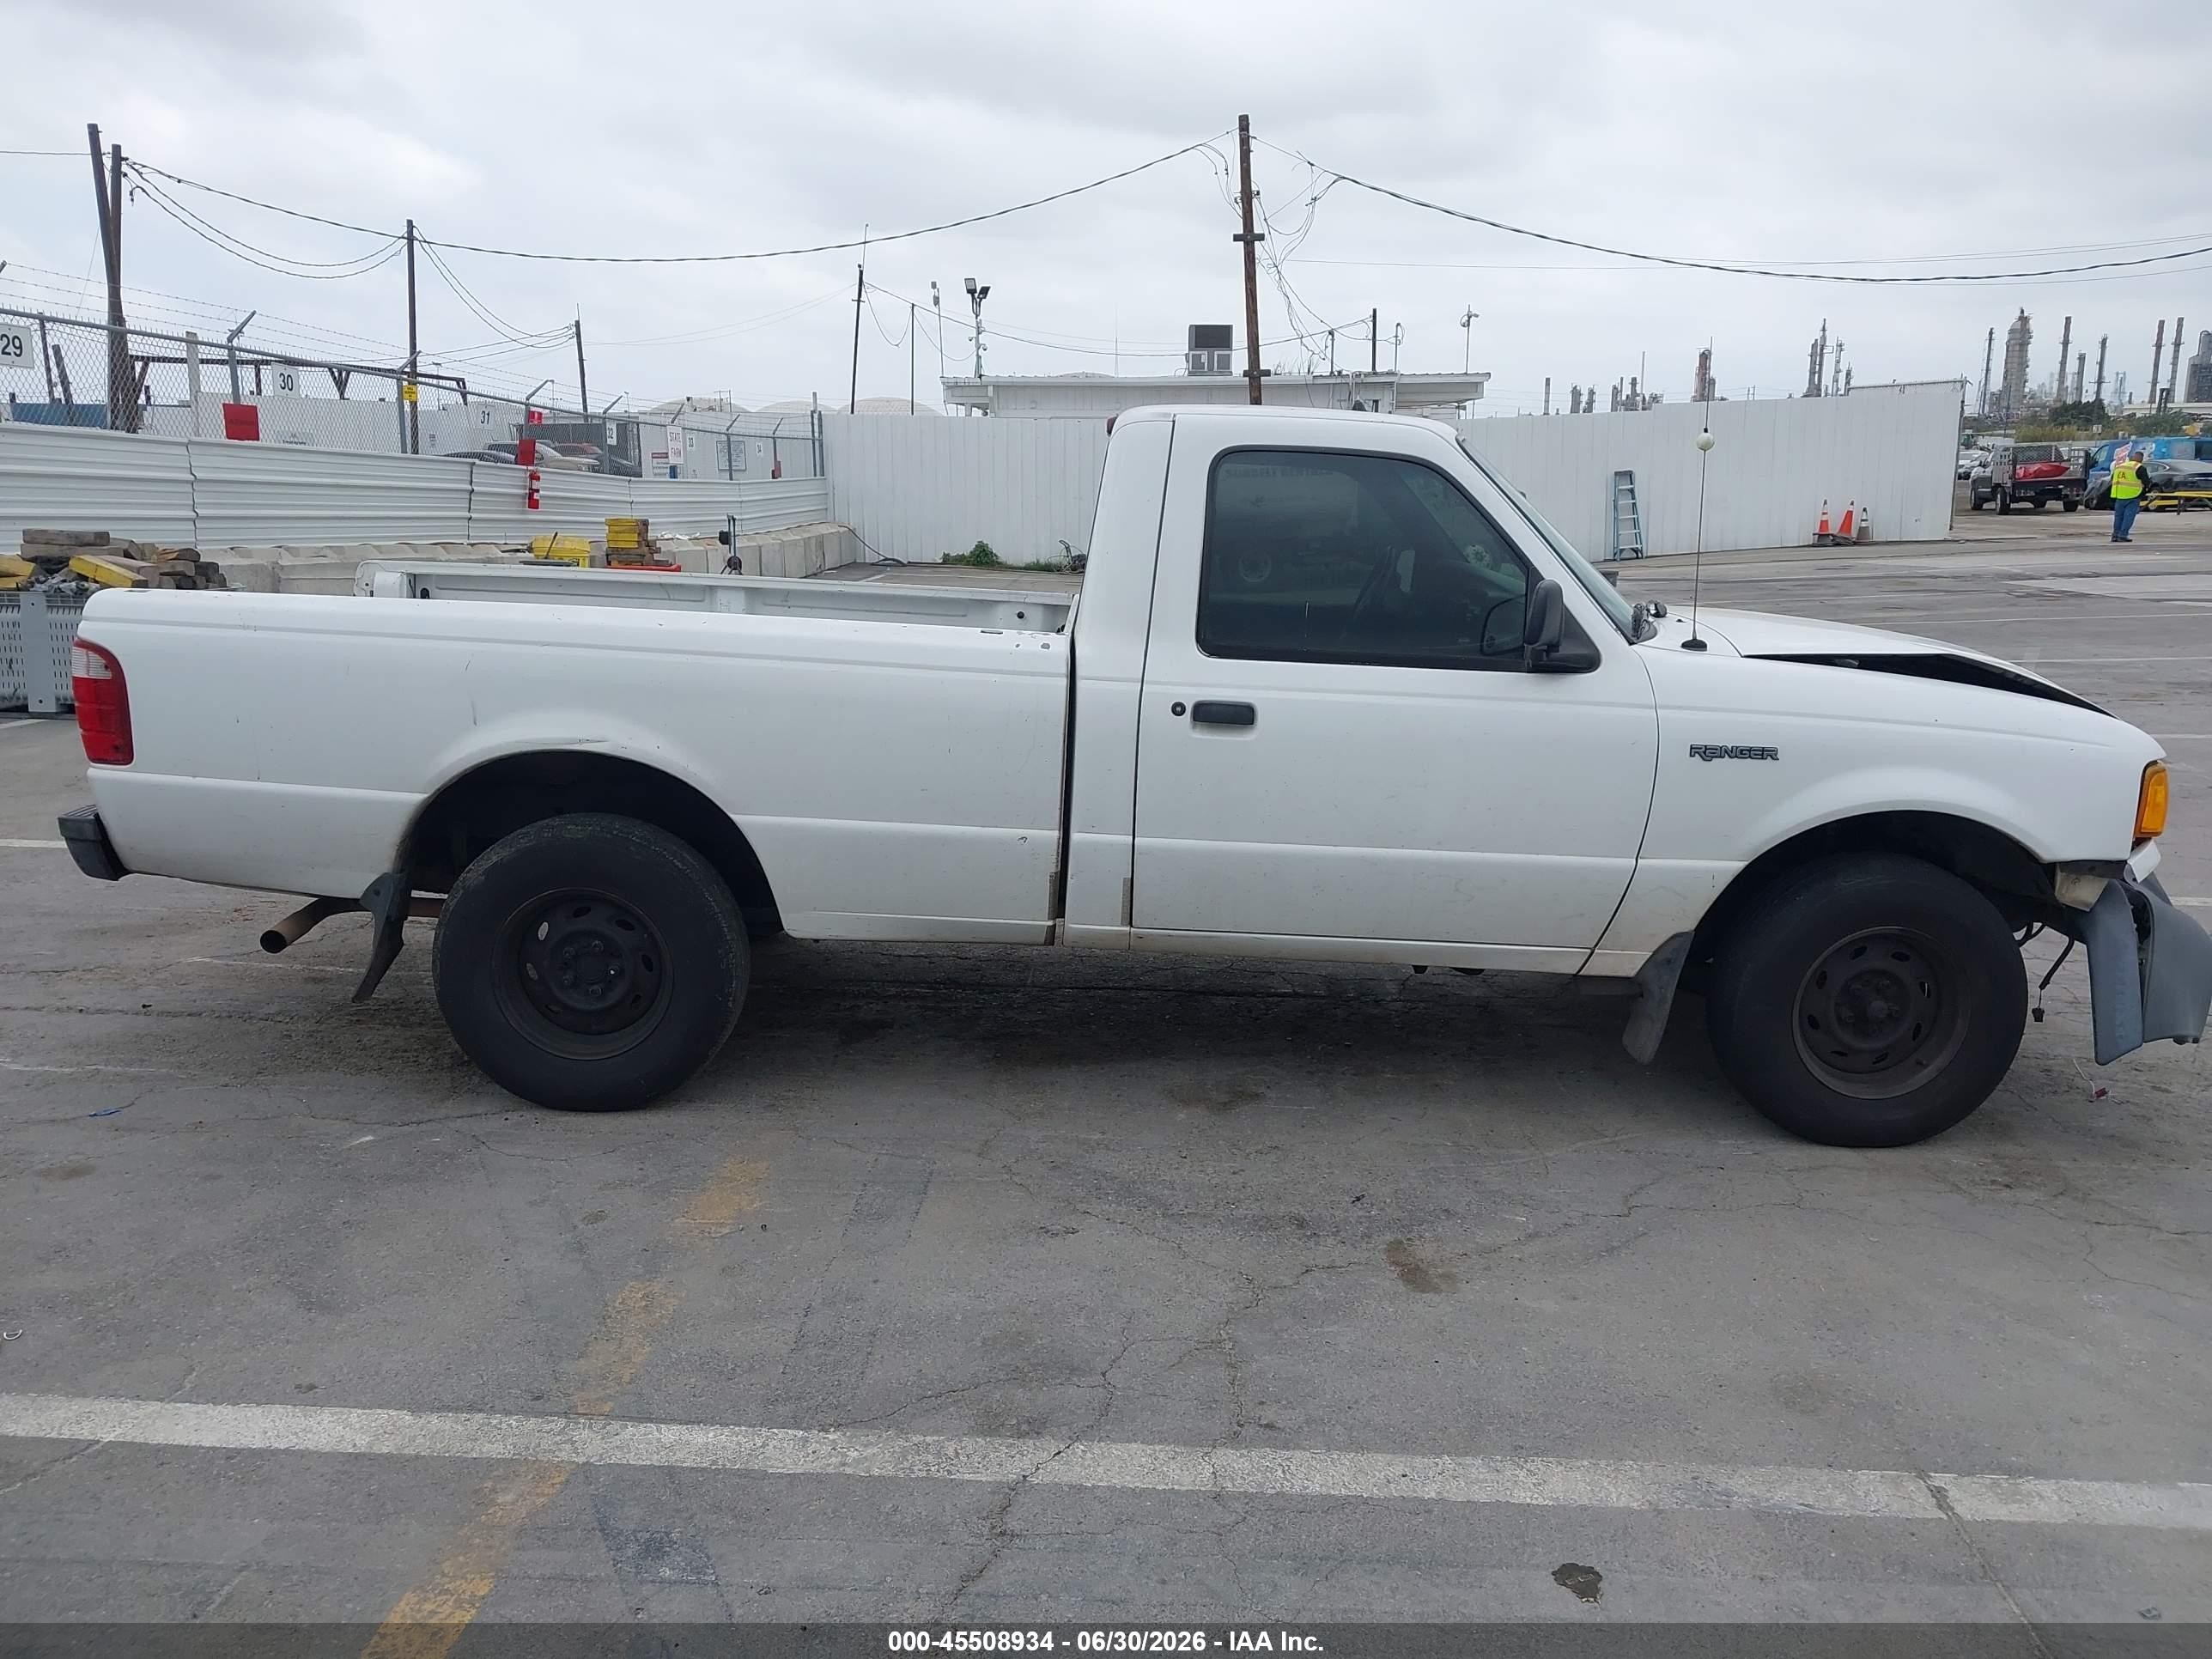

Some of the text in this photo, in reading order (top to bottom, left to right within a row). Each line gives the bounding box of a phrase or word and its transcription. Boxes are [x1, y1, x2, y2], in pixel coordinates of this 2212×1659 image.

[1, 333, 23, 358] 29
[279, 372, 294, 392] 30
[480, 410, 490, 425] 31
[607, 427, 615, 440] 32
[670, 432, 682, 443] STATE
[1689, 744, 1779, 762] RANGER
